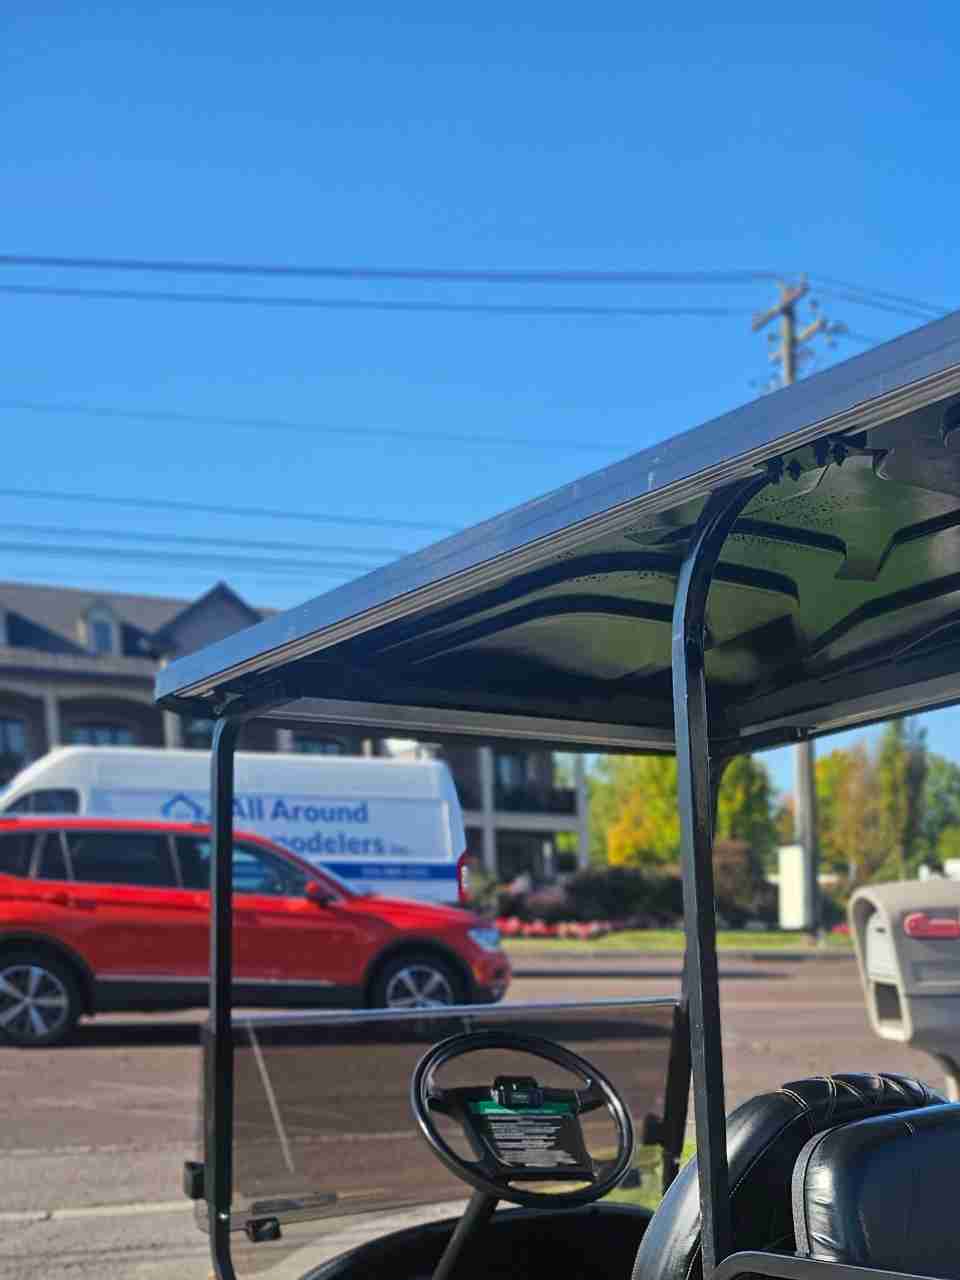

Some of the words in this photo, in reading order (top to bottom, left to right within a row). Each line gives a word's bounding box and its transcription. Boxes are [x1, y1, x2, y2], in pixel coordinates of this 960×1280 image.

[232, 797, 264, 821] All
[270, 798, 369, 823] Around
[272, 831, 385, 855] odelers
